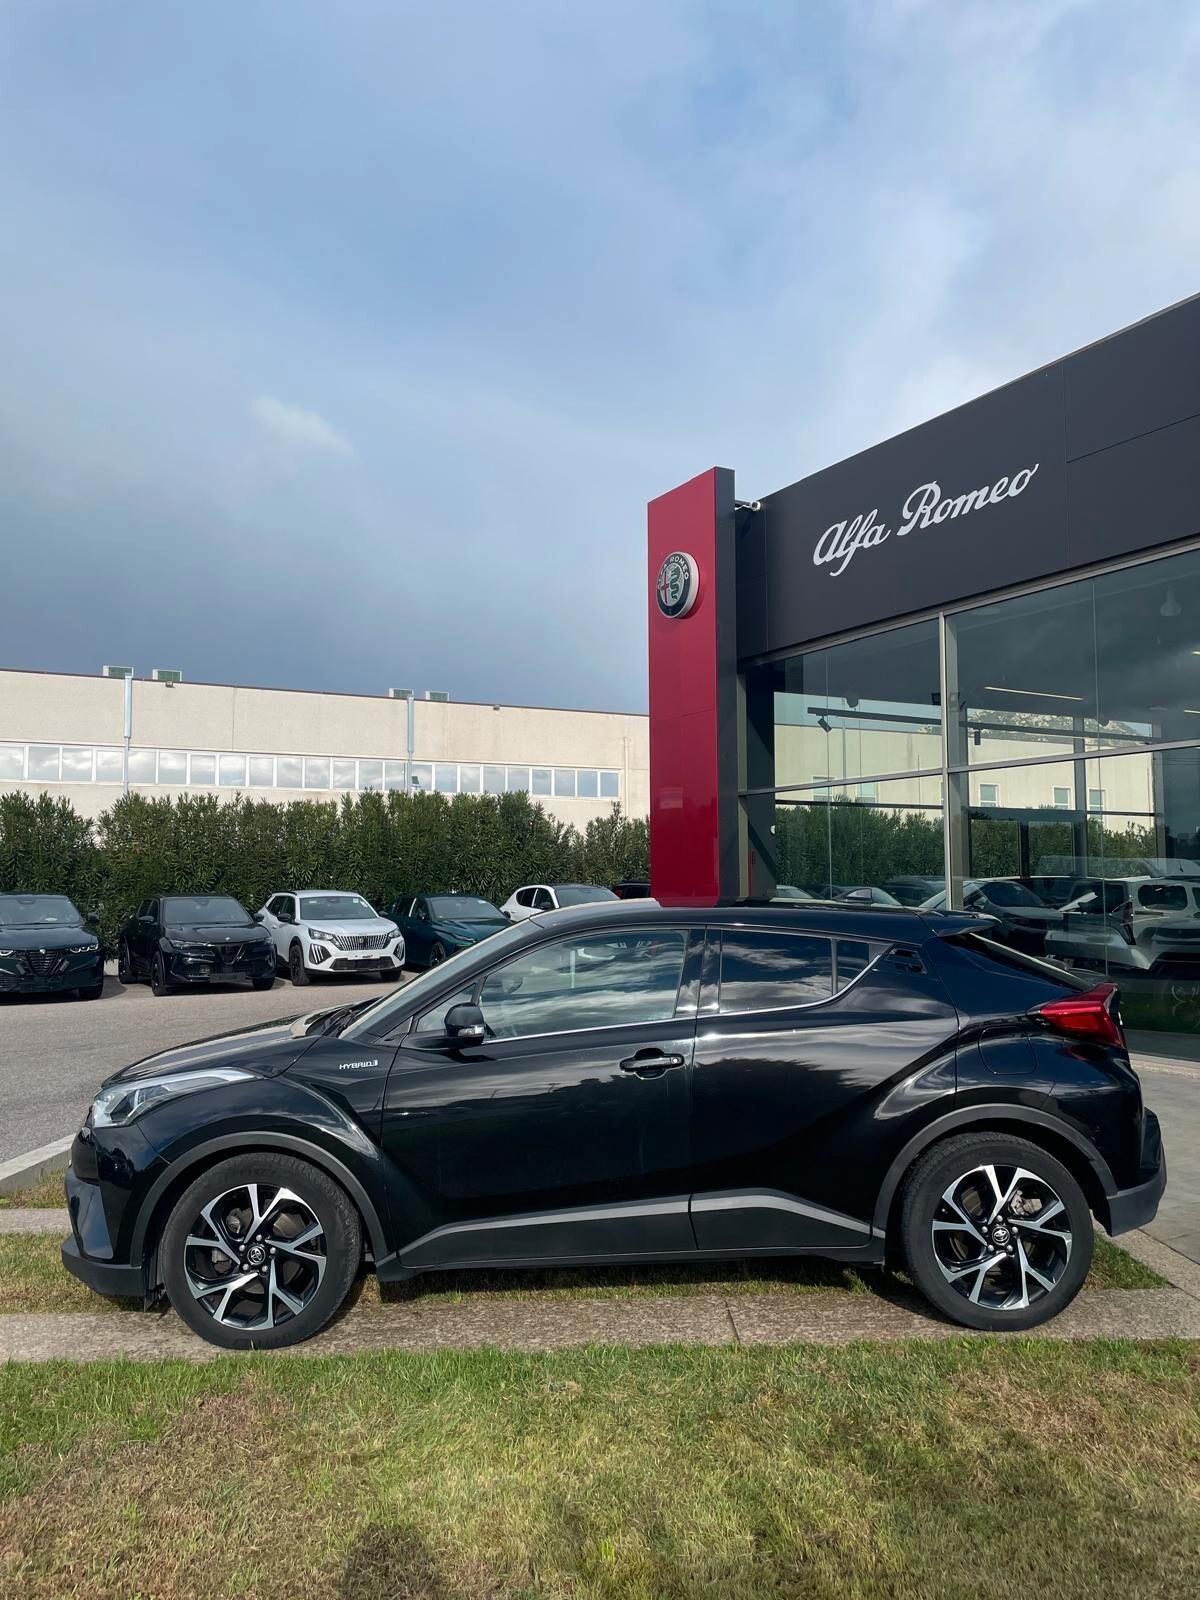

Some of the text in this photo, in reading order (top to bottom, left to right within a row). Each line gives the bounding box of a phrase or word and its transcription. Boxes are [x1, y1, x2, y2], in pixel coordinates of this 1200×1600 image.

[812, 463, 1040, 578] Alfa Romeo
[669, 555, 689, 580] ROMEO
[339, 1061, 372, 1070] HYBRID
